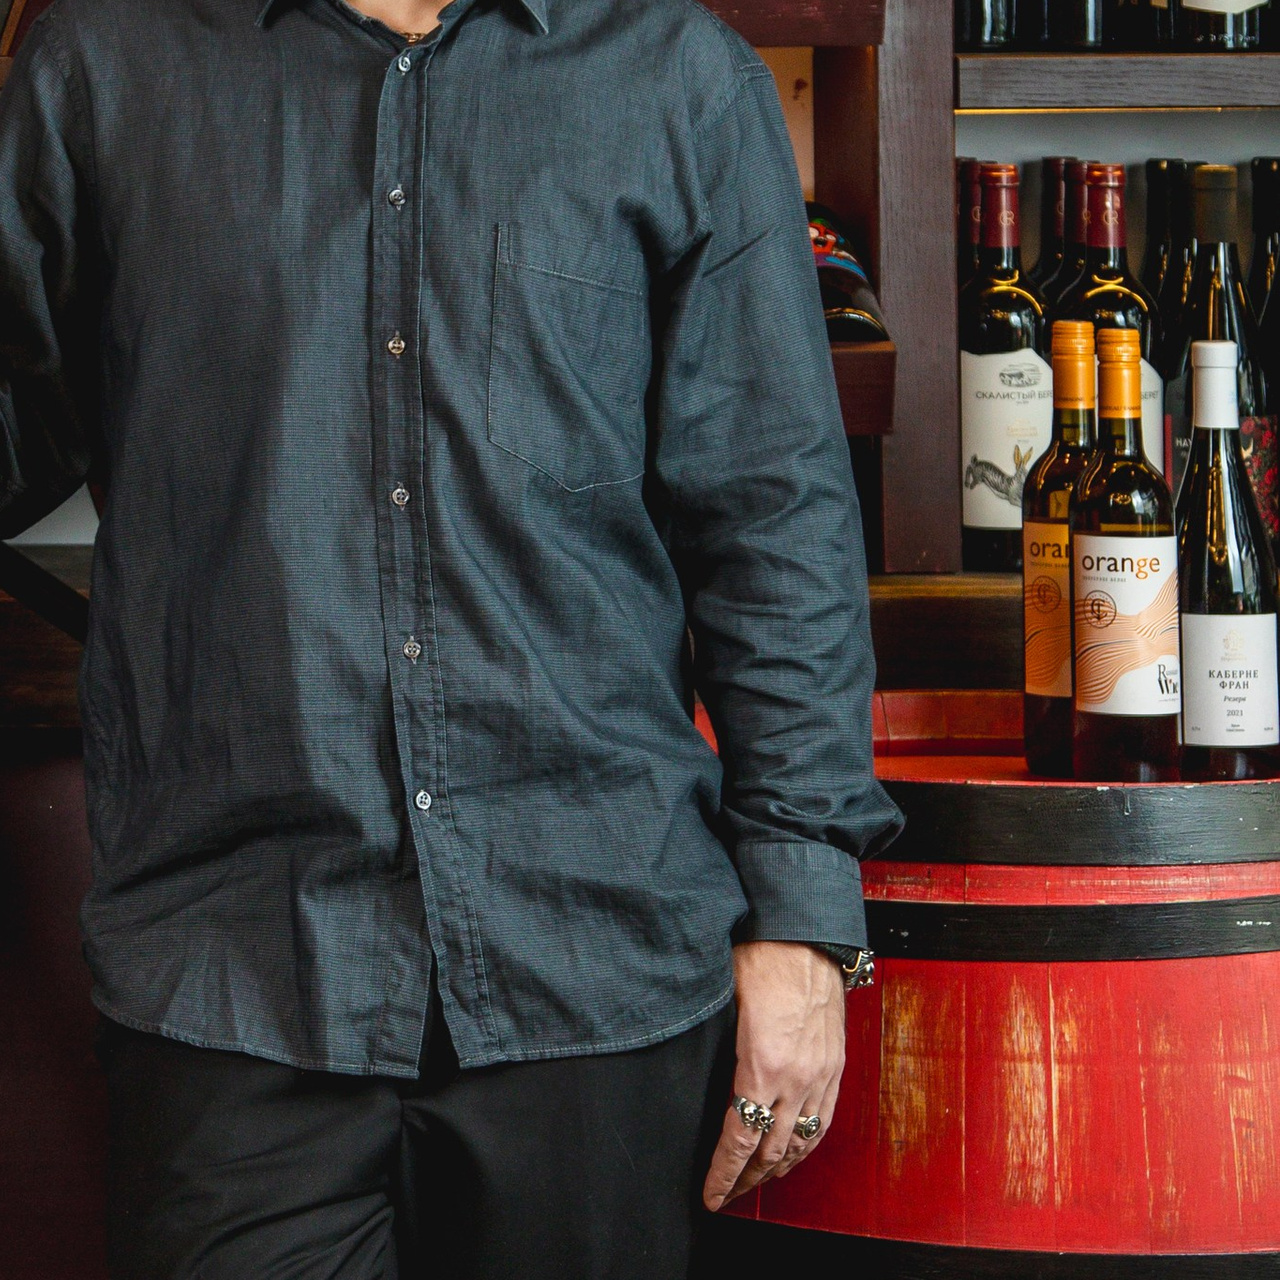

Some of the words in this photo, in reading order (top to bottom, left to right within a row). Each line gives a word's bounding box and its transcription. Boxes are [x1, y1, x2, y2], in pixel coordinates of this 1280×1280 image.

[975, 390, 1035, 400] СКАЛИСТЫЙ
[1082, 555, 1161, 580] orange
[1208, 669, 1259, 679] КАБЕРНЕ
[1219, 680, 1249, 690] ФРАН
[1223, 695, 1247, 704] Резерв
[1226, 709, 1243, 717] 2021
